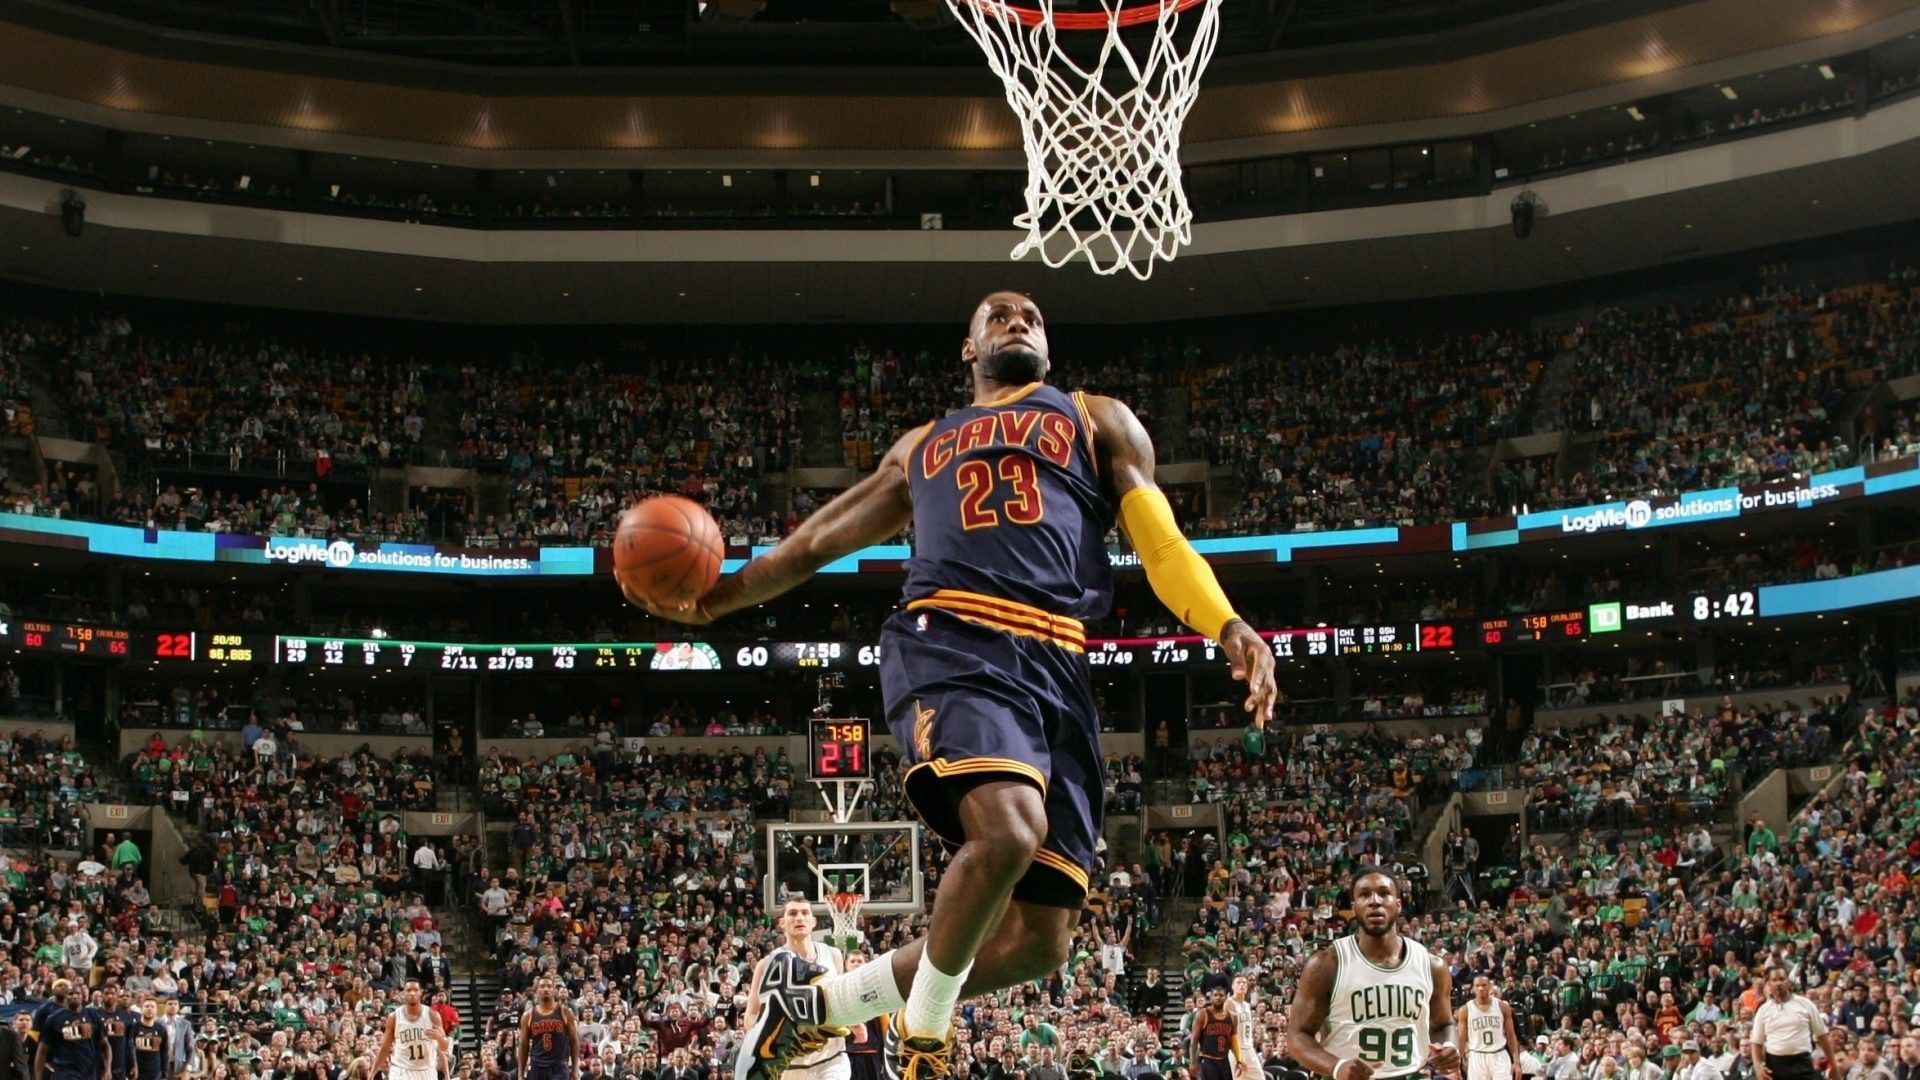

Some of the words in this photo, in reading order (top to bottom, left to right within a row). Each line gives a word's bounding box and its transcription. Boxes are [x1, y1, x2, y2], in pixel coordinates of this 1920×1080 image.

[924, 411, 1076, 479] CAVS
[957, 455, 1043, 531] 23
[1655, 498, 1733, 520] solutions
[1736, 493, 1761, 510] for
[1765, 484, 1840, 506] business.
[359, 549, 431, 567] solutions
[434, 553, 458, 567] for
[461, 554, 531, 569] business.
[1626, 602, 1674, 619] Bank
[1693, 592, 1754, 620] 8:42
[1593, 607, 1618, 627] TD
[1421, 626, 1453, 647] 22
[1486, 631, 1501, 643] 60
[1566, 624, 1581, 635] 65
[26, 634, 42, 647] 60
[110, 642, 126, 653] 65
[156, 634, 190, 656] 22
[286, 639, 307, 649] REB
[324, 641, 344, 650] AST
[362, 642, 381, 653] STL
[400, 643, 415, 654] TO
[444, 646, 464, 655] 3PT
[501, 647, 516, 656] FG
[552, 647, 577, 657] FG%
[1103, 642, 1118, 651] FG
[1156, 640, 1176, 650] 3PT
[1272, 633, 1293, 644] AST
[1306, 632, 1326, 642] REB
[1339, 637, 1356, 645] MIL
[1367, 644, 1373, 653] 2
[1406, 643, 1412, 651] 2
[736, 646, 768, 667] 60
[795, 643, 841, 659] 7:58
[1088, 652, 1133, 665] 23/49
[1152, 649, 1188, 664] 7/19
[1205, 648, 1215, 660] 8
[1275, 644, 1293, 656] 11
[1308, 642, 1327, 655] 29
[287, 650, 306, 662] 29
[325, 651, 343, 664] 12
[365, 652, 375, 665] 5
[402, 654, 412, 667] 7
[441, 656, 478, 669] 2/11
[488, 656, 534, 670] 23/53
[555, 656, 575, 669] 43
[629, 657, 637, 666] 1
[798, 658, 819, 666] QTR
[821, 659, 829, 667] 3
[828, 725, 863, 742] 7:58
[631, 740, 639, 751] 6
[821, 743, 859, 773] 21
[110, 807, 124, 817] EXIT
[436, 814, 449, 824] EXIT
[1176, 807, 1189, 817] EXIT
[1350, 984, 1425, 1024] CELTICS
[531, 1019, 564, 1033] CAVS
[1472, 1015, 1500, 1031] CELTICS
[543, 1033, 552, 1050] 5
[1482, 1030, 1493, 1046] 0
[408, 1044, 424, 1060] 11
[1358, 1027, 1413, 1067] 99
